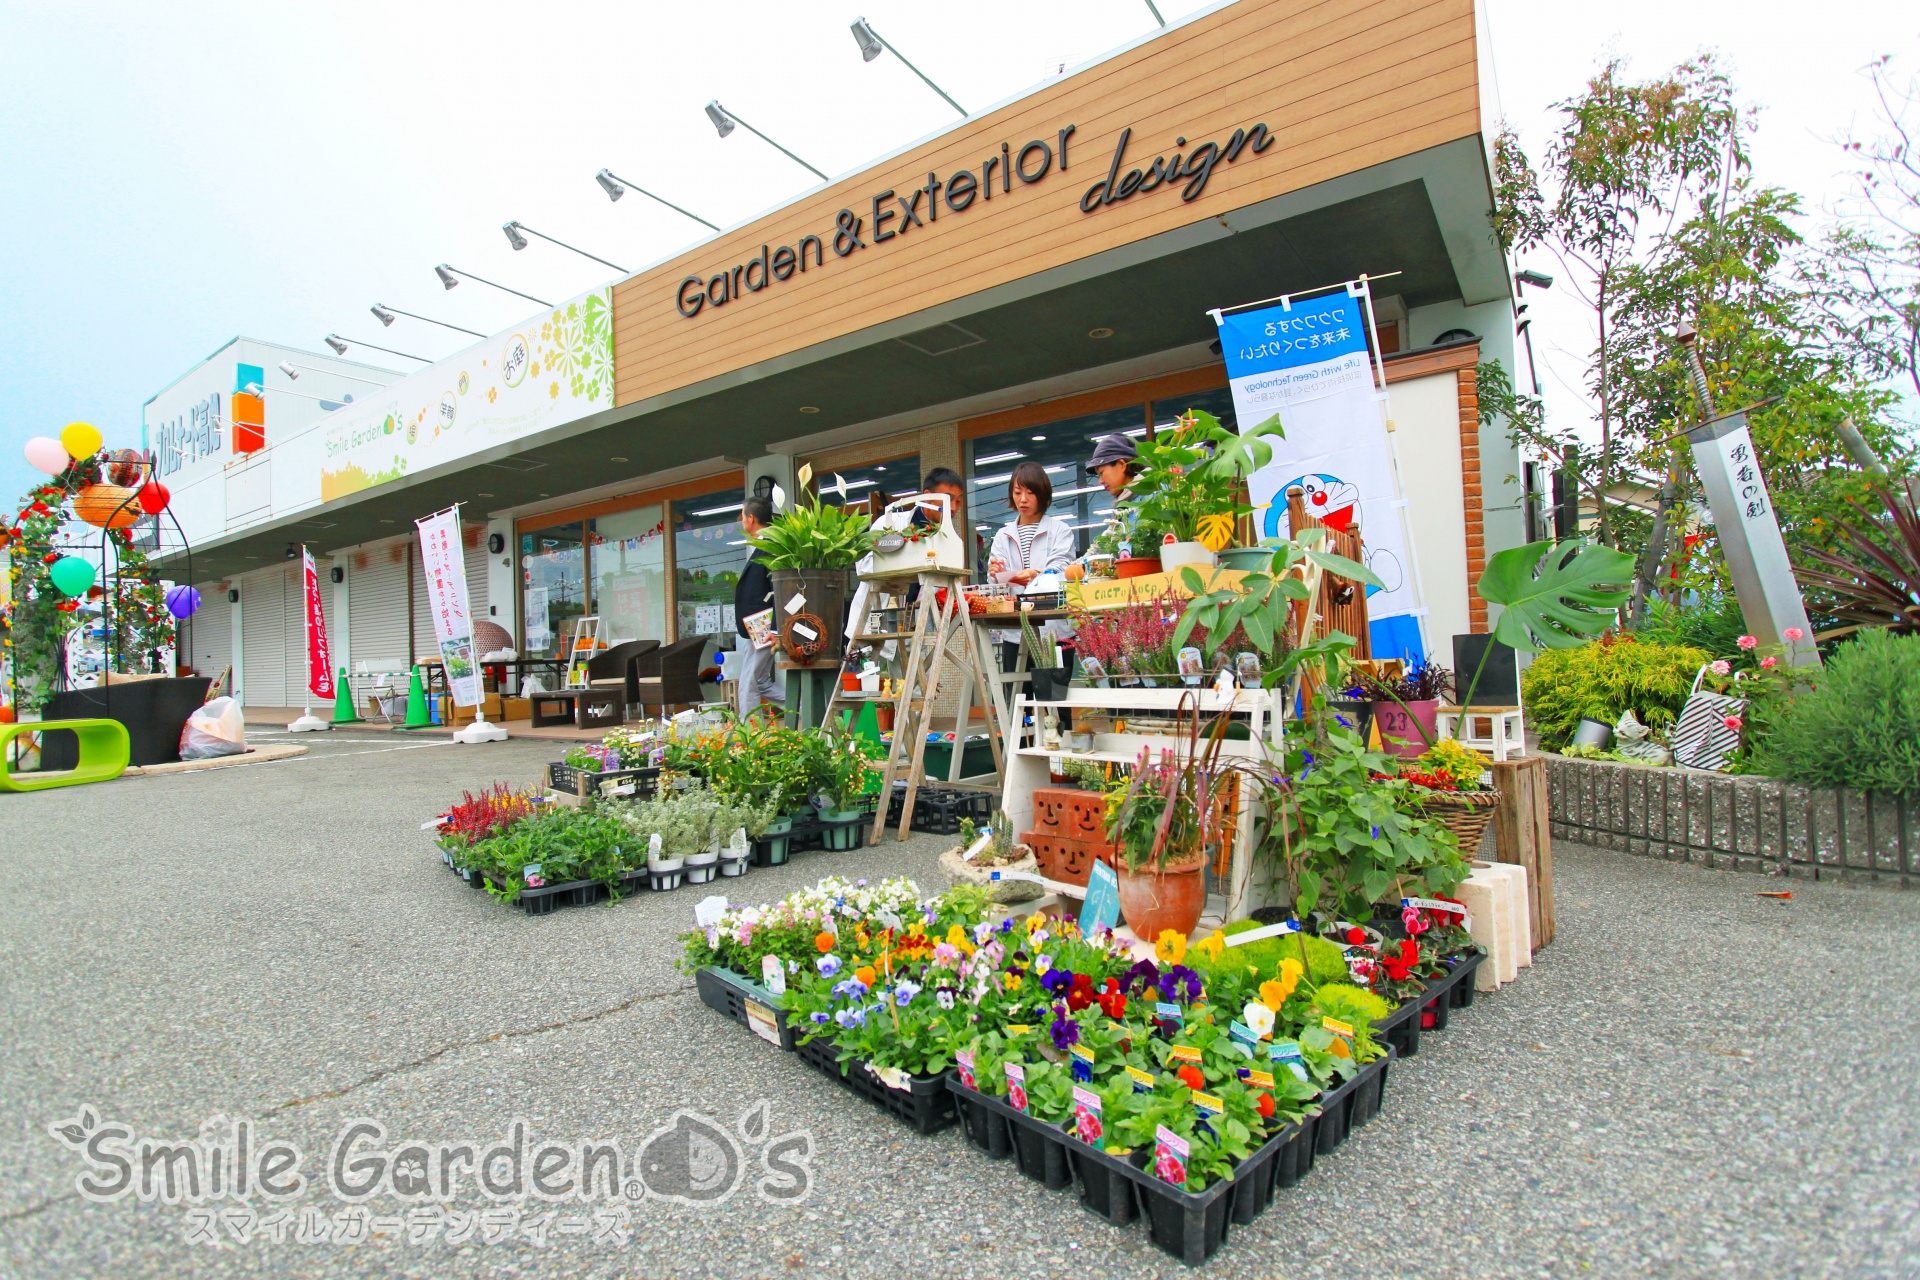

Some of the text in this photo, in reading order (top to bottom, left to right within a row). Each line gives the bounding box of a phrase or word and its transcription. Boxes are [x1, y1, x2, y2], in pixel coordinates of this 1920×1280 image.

[675, 122, 1275, 318] Garden & Exterior design
[503, 343, 526, 381] お庭
[327, 436, 349, 458] Smile
[351, 424, 382, 449] Garden
[1730, 443, 1766, 521] 勇者の剣
[1385, 712, 1408, 731] 23
[1158, 1006, 1180, 1015] パンジー
[1232, 1024, 1256, 1040] パンジー
[1175, 1049, 1200, 1058] パンジー
[1271, 1048, 1299, 1057] パンジー
[1194, 1097, 1221, 1110] パンジー
[1157, 1131, 1186, 1150] パンジー
